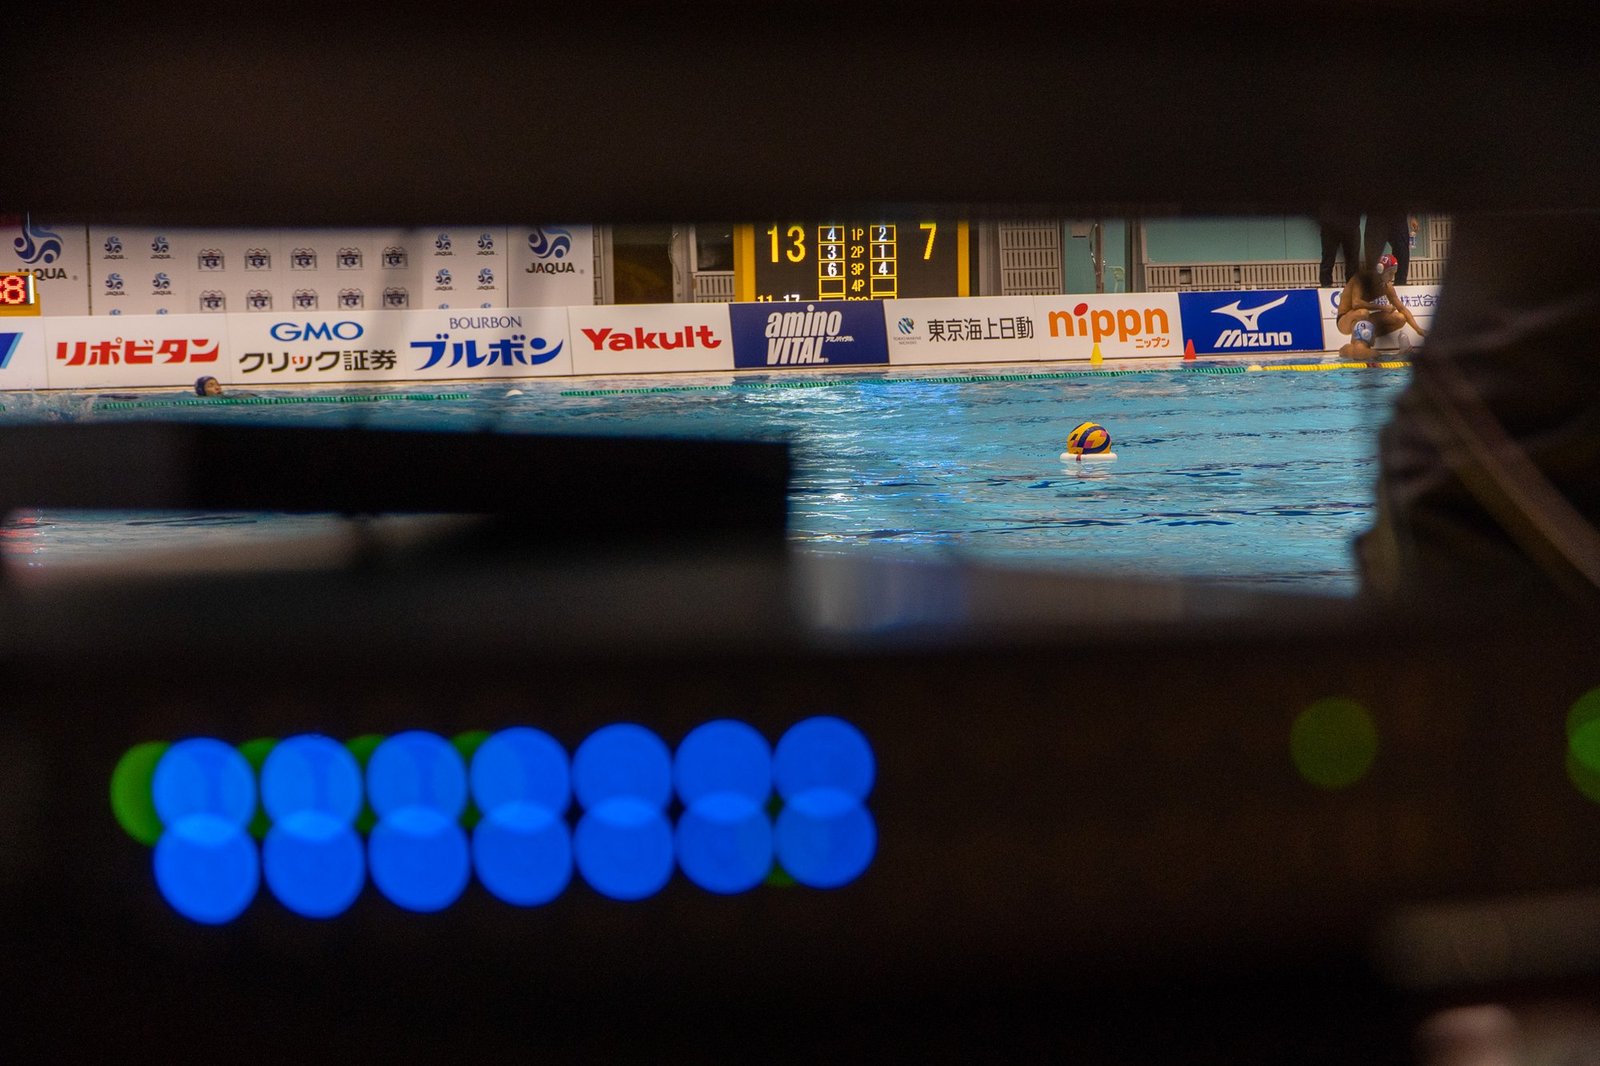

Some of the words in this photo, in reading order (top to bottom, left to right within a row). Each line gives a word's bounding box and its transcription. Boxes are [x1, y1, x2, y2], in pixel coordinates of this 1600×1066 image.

[767, 225, 806, 262] 13
[827, 227, 836, 242] 4
[851, 228, 864, 241] 1P
[878, 227, 887, 241] 2
[919, 222, 937, 260] 7
[827, 245, 837, 260] 3
[850, 246, 865, 258] 2P
[879, 245, 886, 259] 1
[525, 262, 575, 274] JAQUA
[827, 262, 837, 277] 6
[850, 264, 865, 275] 3P
[878, 262, 888, 276] 4
[851, 279, 865, 292] 4P
[270, 321, 364, 342] GMO
[449, 316, 522, 330] BOURBON
[765, 304, 843, 337] amino
[927, 316, 1035, 343] 東京海上日動
[1048, 302, 1170, 343] nippn
[581, 325, 723, 352] Yakult
[766, 336, 827, 365] VITAL
[1135, 338, 1171, 349] ニップン
[56, 337, 220, 366] リポビタン
[239, 349, 397, 373] クリック証券
[409, 333, 564, 371] ブルボン
